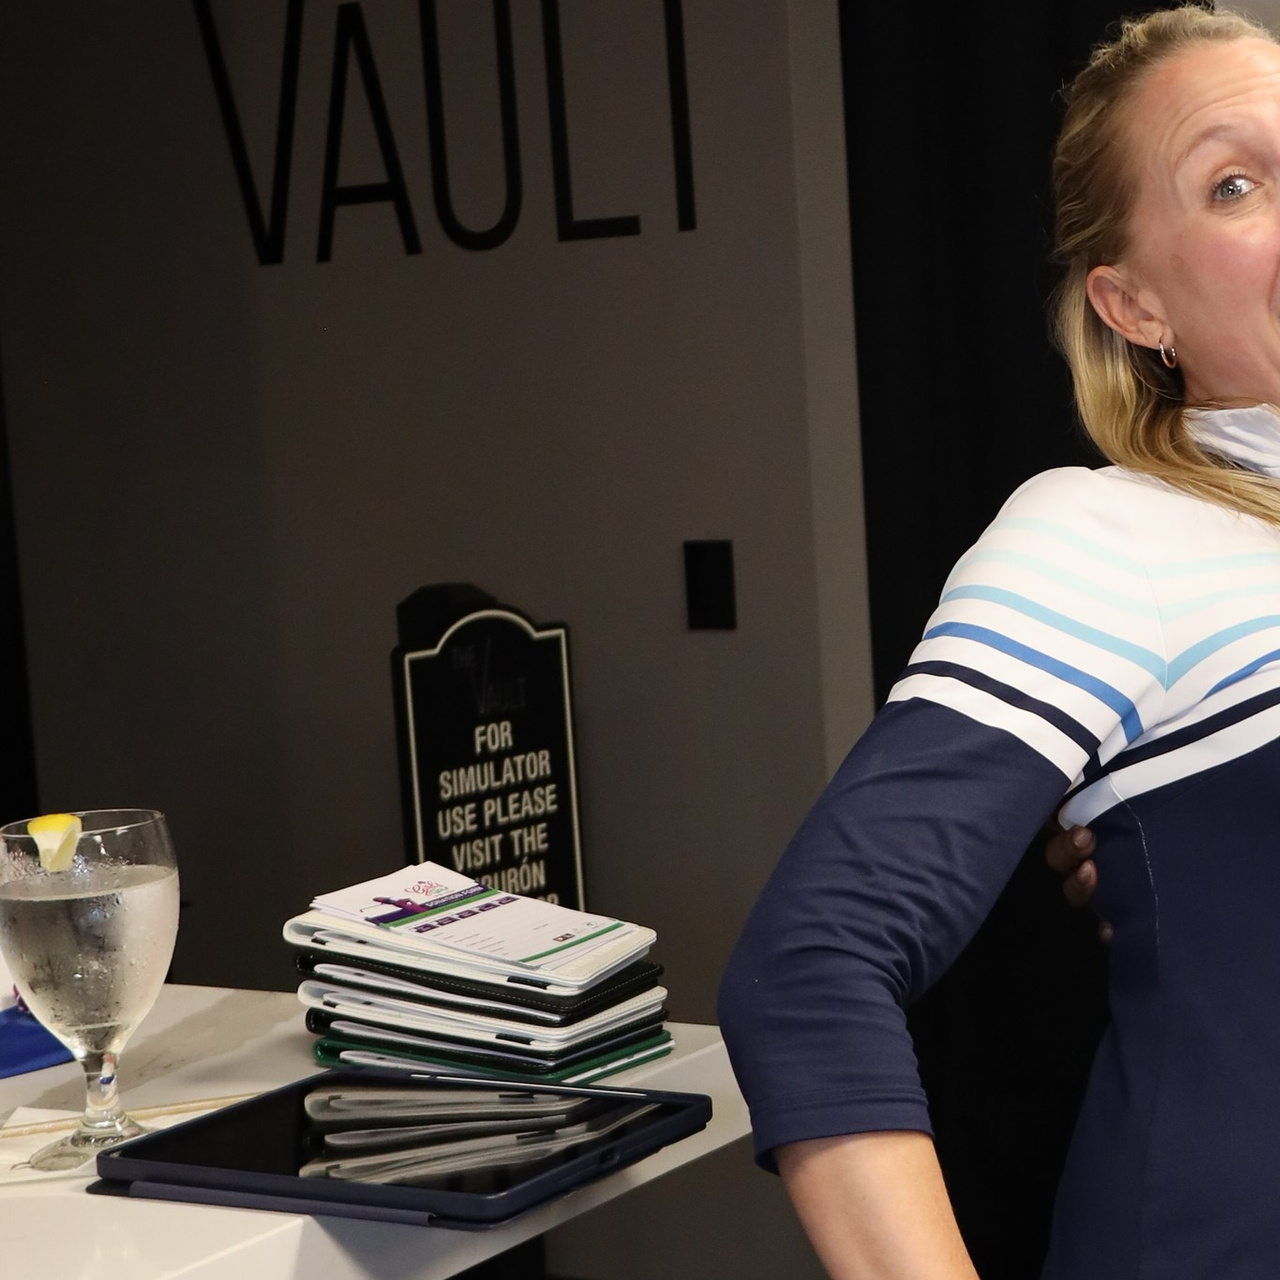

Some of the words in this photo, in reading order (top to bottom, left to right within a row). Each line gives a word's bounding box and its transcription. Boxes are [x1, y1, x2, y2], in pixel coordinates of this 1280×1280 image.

[474, 720, 514, 756] FOR
[438, 749, 551, 801] SIMULATOR
[437, 807, 477, 840] USE
[483, 783, 558, 826] PLEASE
[452, 833, 503, 871] VISIT
[510, 822, 549, 857] THE
